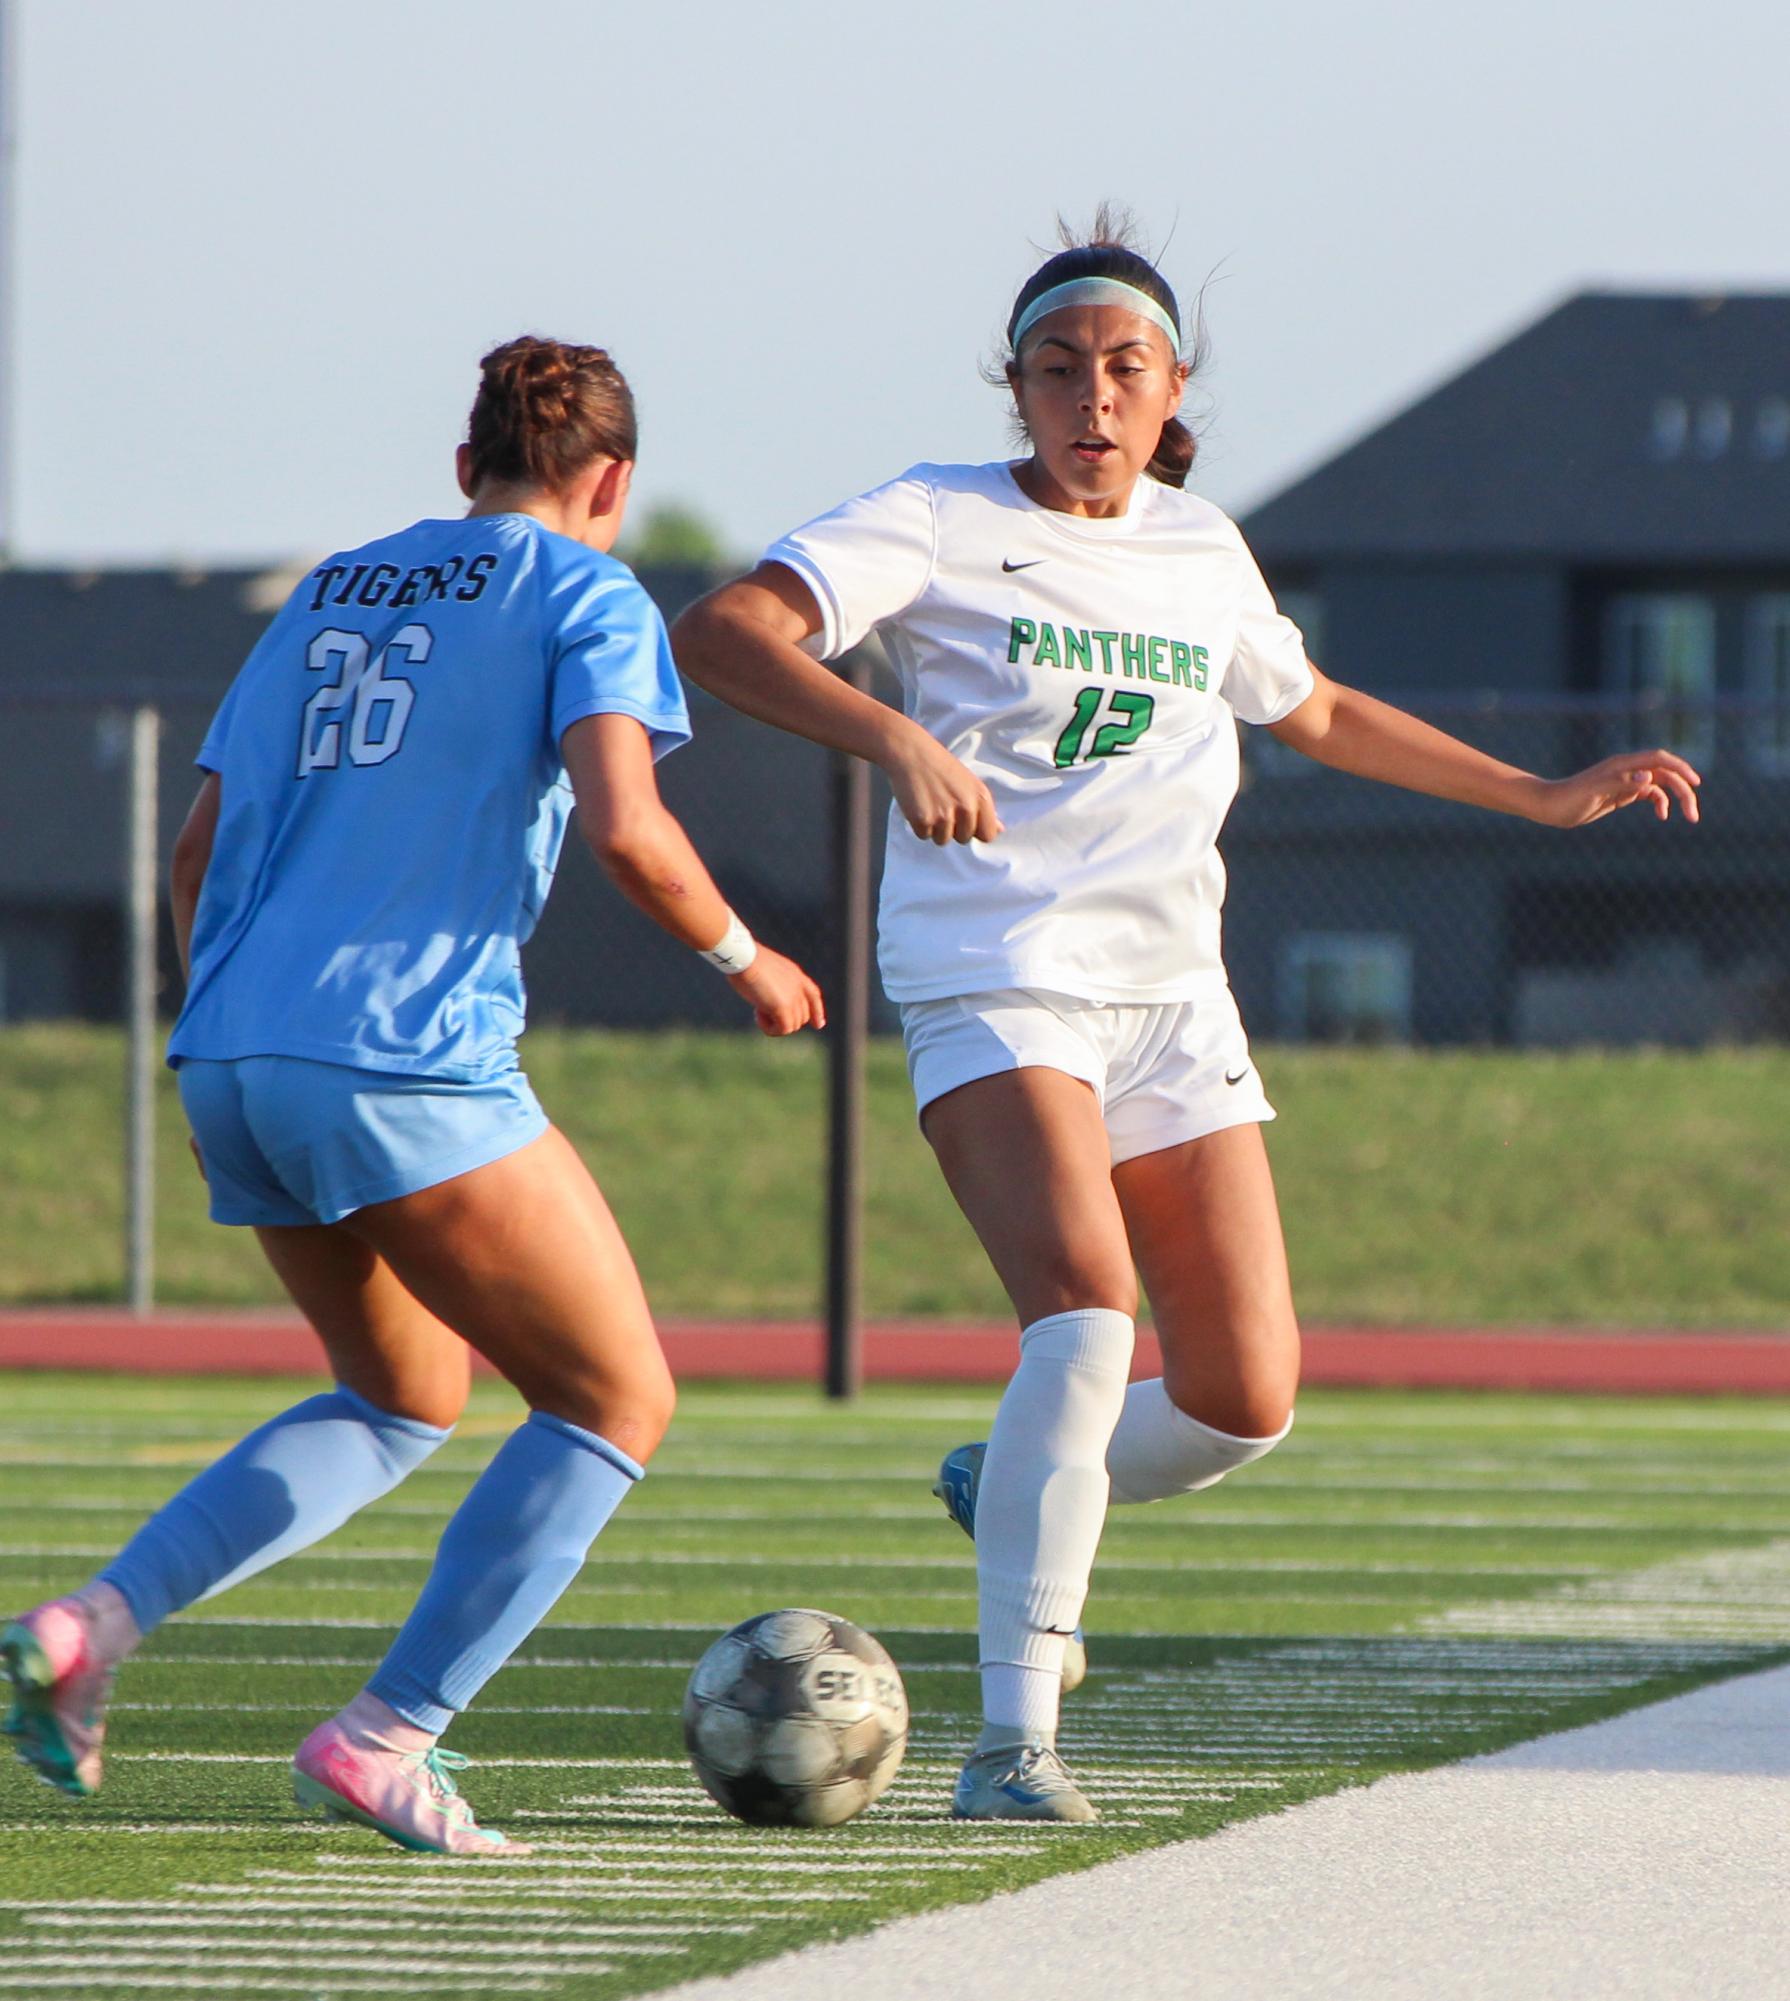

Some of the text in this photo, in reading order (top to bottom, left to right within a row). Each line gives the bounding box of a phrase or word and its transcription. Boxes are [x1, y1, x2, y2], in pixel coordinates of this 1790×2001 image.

[309, 554, 498, 611] TIGERS
[1007, 616, 1209, 692] PANTHERS
[295, 623, 433, 779] 26
[1054, 687, 1155, 769] 12
